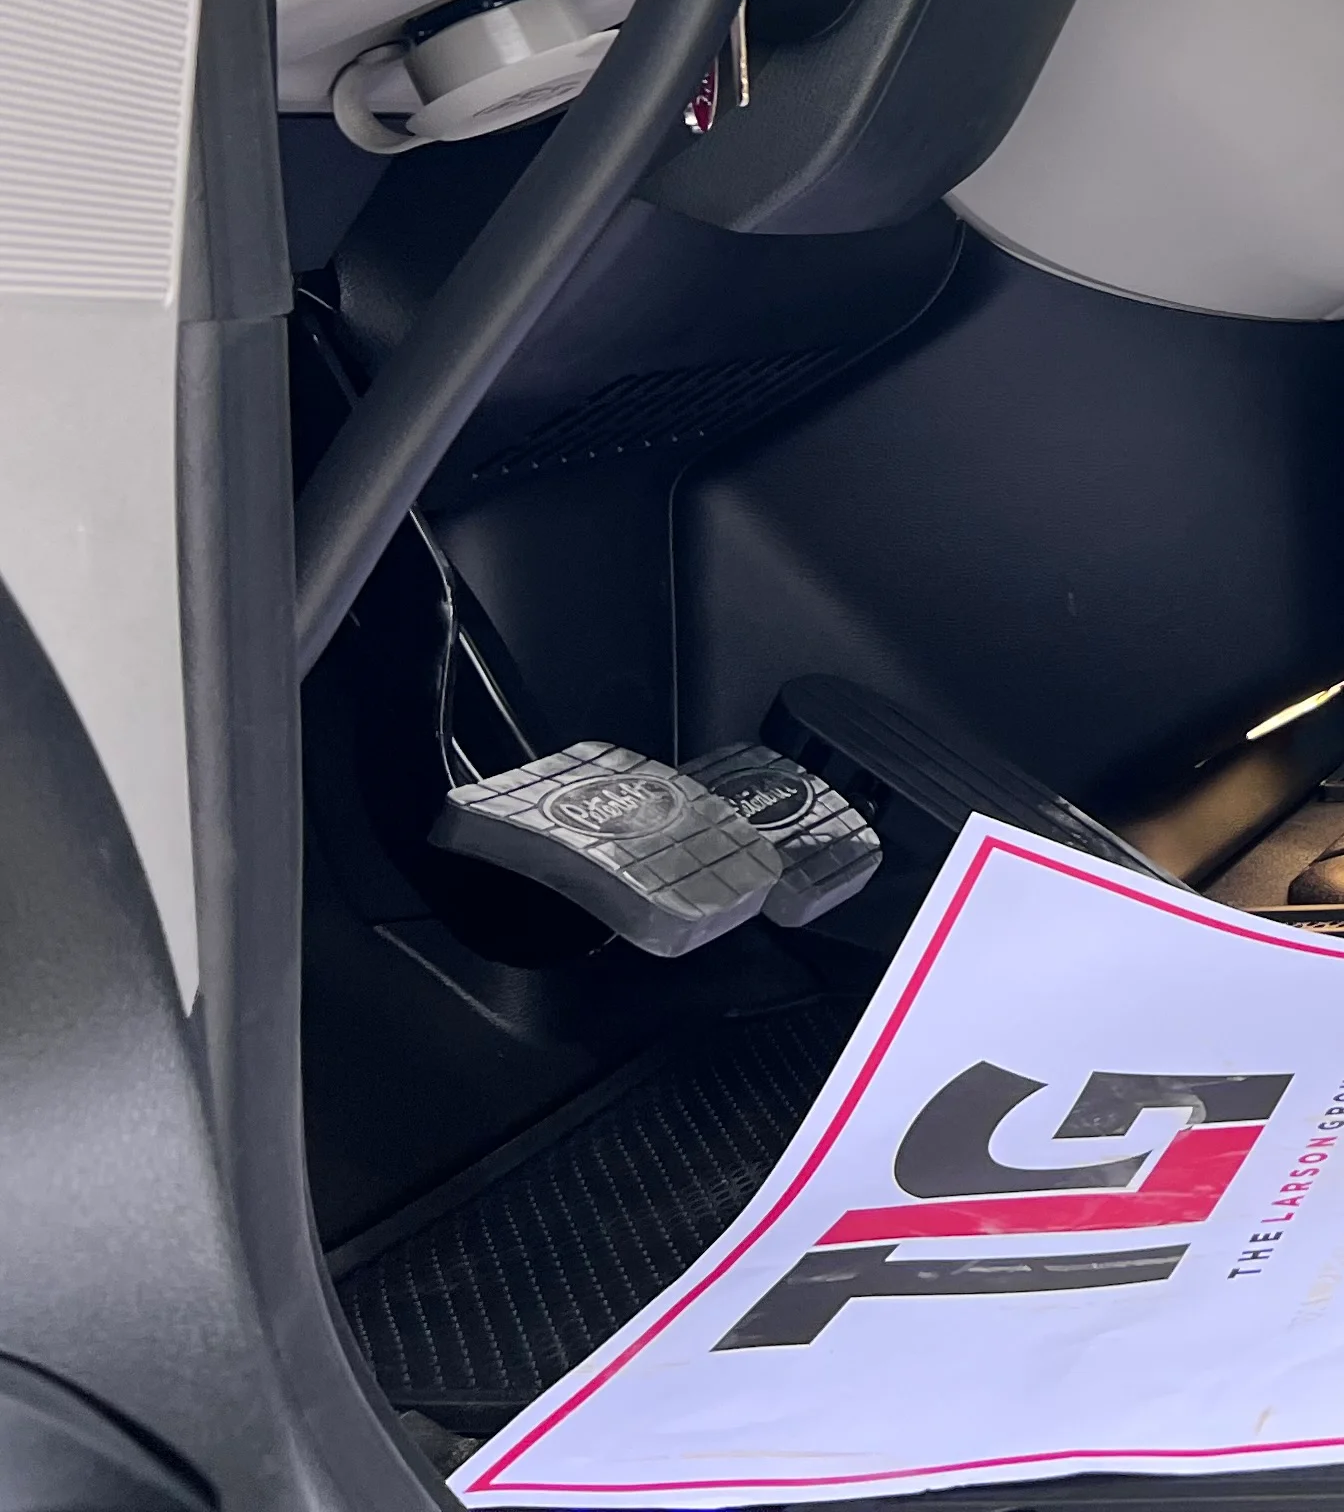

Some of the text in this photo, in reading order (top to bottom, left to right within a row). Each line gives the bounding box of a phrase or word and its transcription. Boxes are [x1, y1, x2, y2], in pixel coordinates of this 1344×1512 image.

[565, 779, 653, 829] Peterbilt
[711, 1059, 1294, 1351] TLG
[1227, 1230, 1284, 1280] THE
[1260, 1135, 1339, 1224] LARSON
